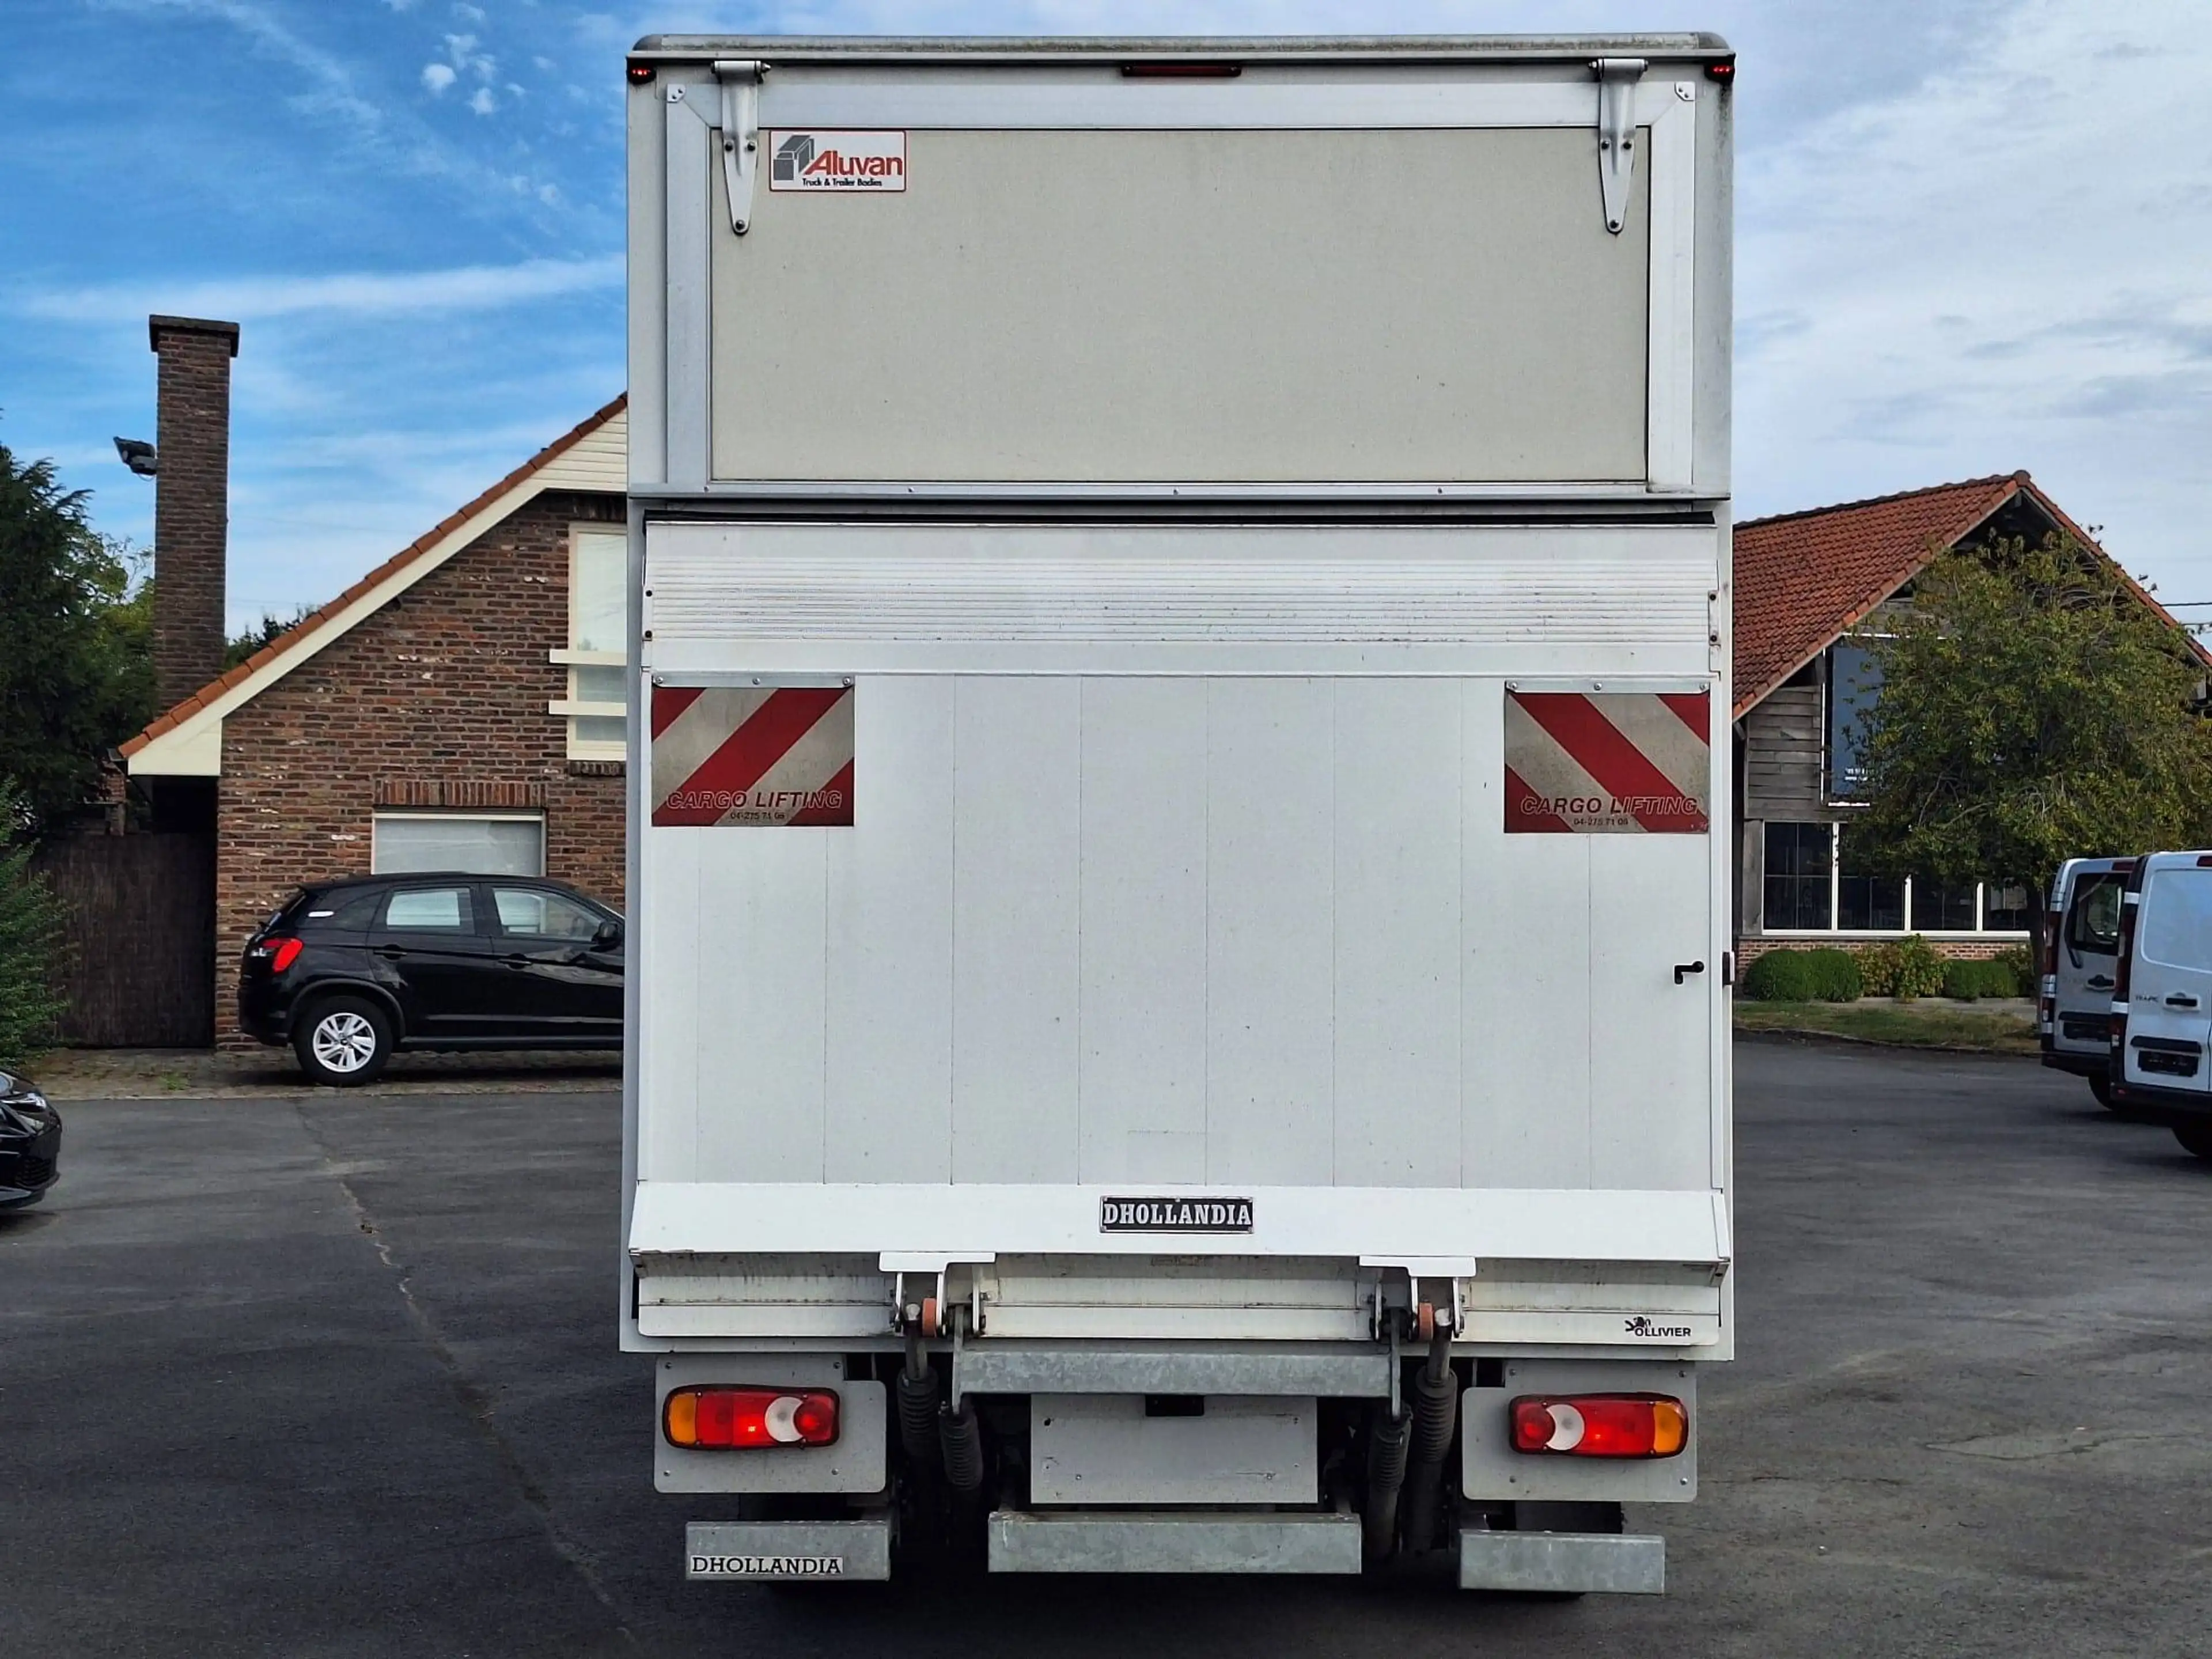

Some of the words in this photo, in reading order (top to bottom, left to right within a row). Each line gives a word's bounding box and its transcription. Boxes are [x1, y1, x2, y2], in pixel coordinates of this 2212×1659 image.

[804, 150, 903, 175] Aluvan
[802, 177, 821, 186] Truck
[824, 178, 830, 186] &
[833, 177, 855, 186] Trailer
[857, 177, 882, 186] Bodies
[667, 790, 747, 809] CARGO
[755, 790, 842, 809] LIFTING
[1521, 795, 1602, 815] CARGO
[1610, 796, 1698, 815] LIFTING
[1103, 1203, 1252, 1225] DHOLLANDIA
[1634, 1327, 1691, 1336] OLLIVIER
[692, 1557, 840, 1573] DHOLLANDIA
